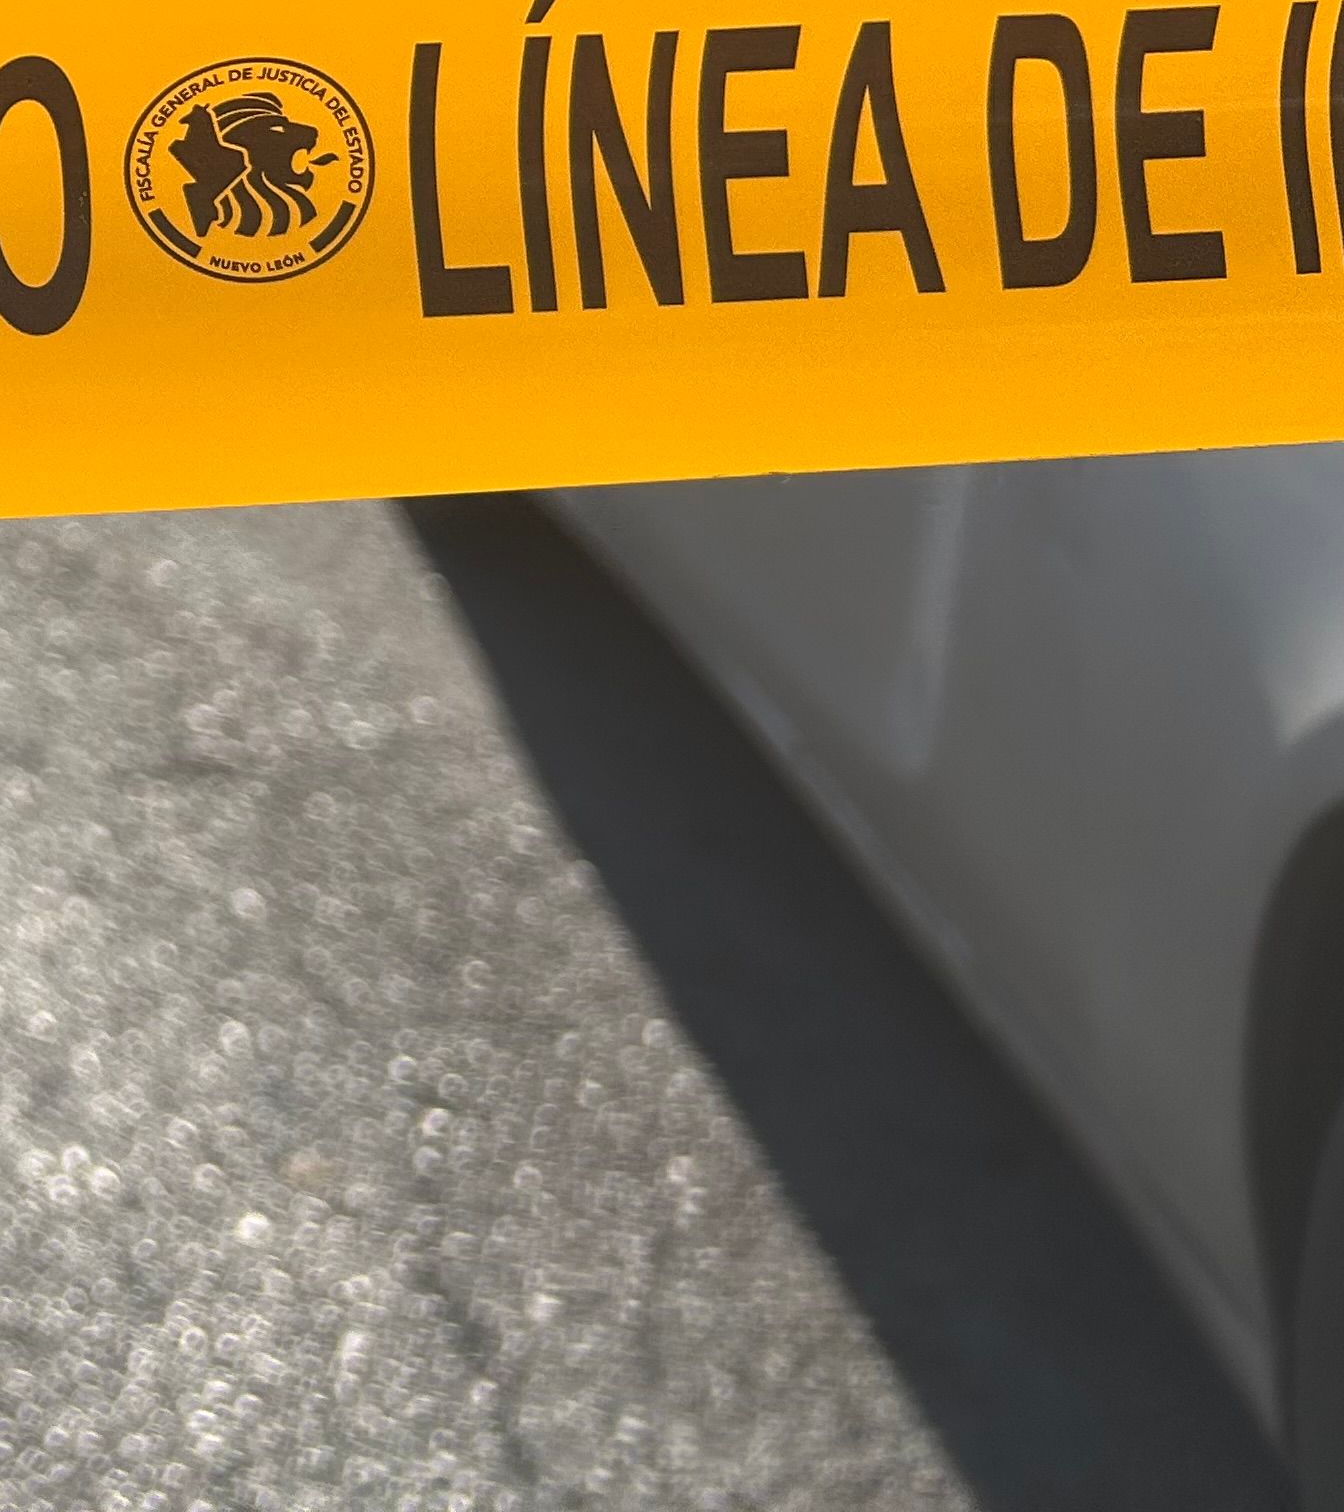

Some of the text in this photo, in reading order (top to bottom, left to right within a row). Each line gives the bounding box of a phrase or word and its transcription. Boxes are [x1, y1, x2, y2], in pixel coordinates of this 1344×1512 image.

[135, 66, 365, 202] FISCALÍA GENERAL DE JUSTICIA DEL ESTADO
[986, 5, 1228, 290] DE
[209, 251, 306, 274] NUEVO LEÓN
